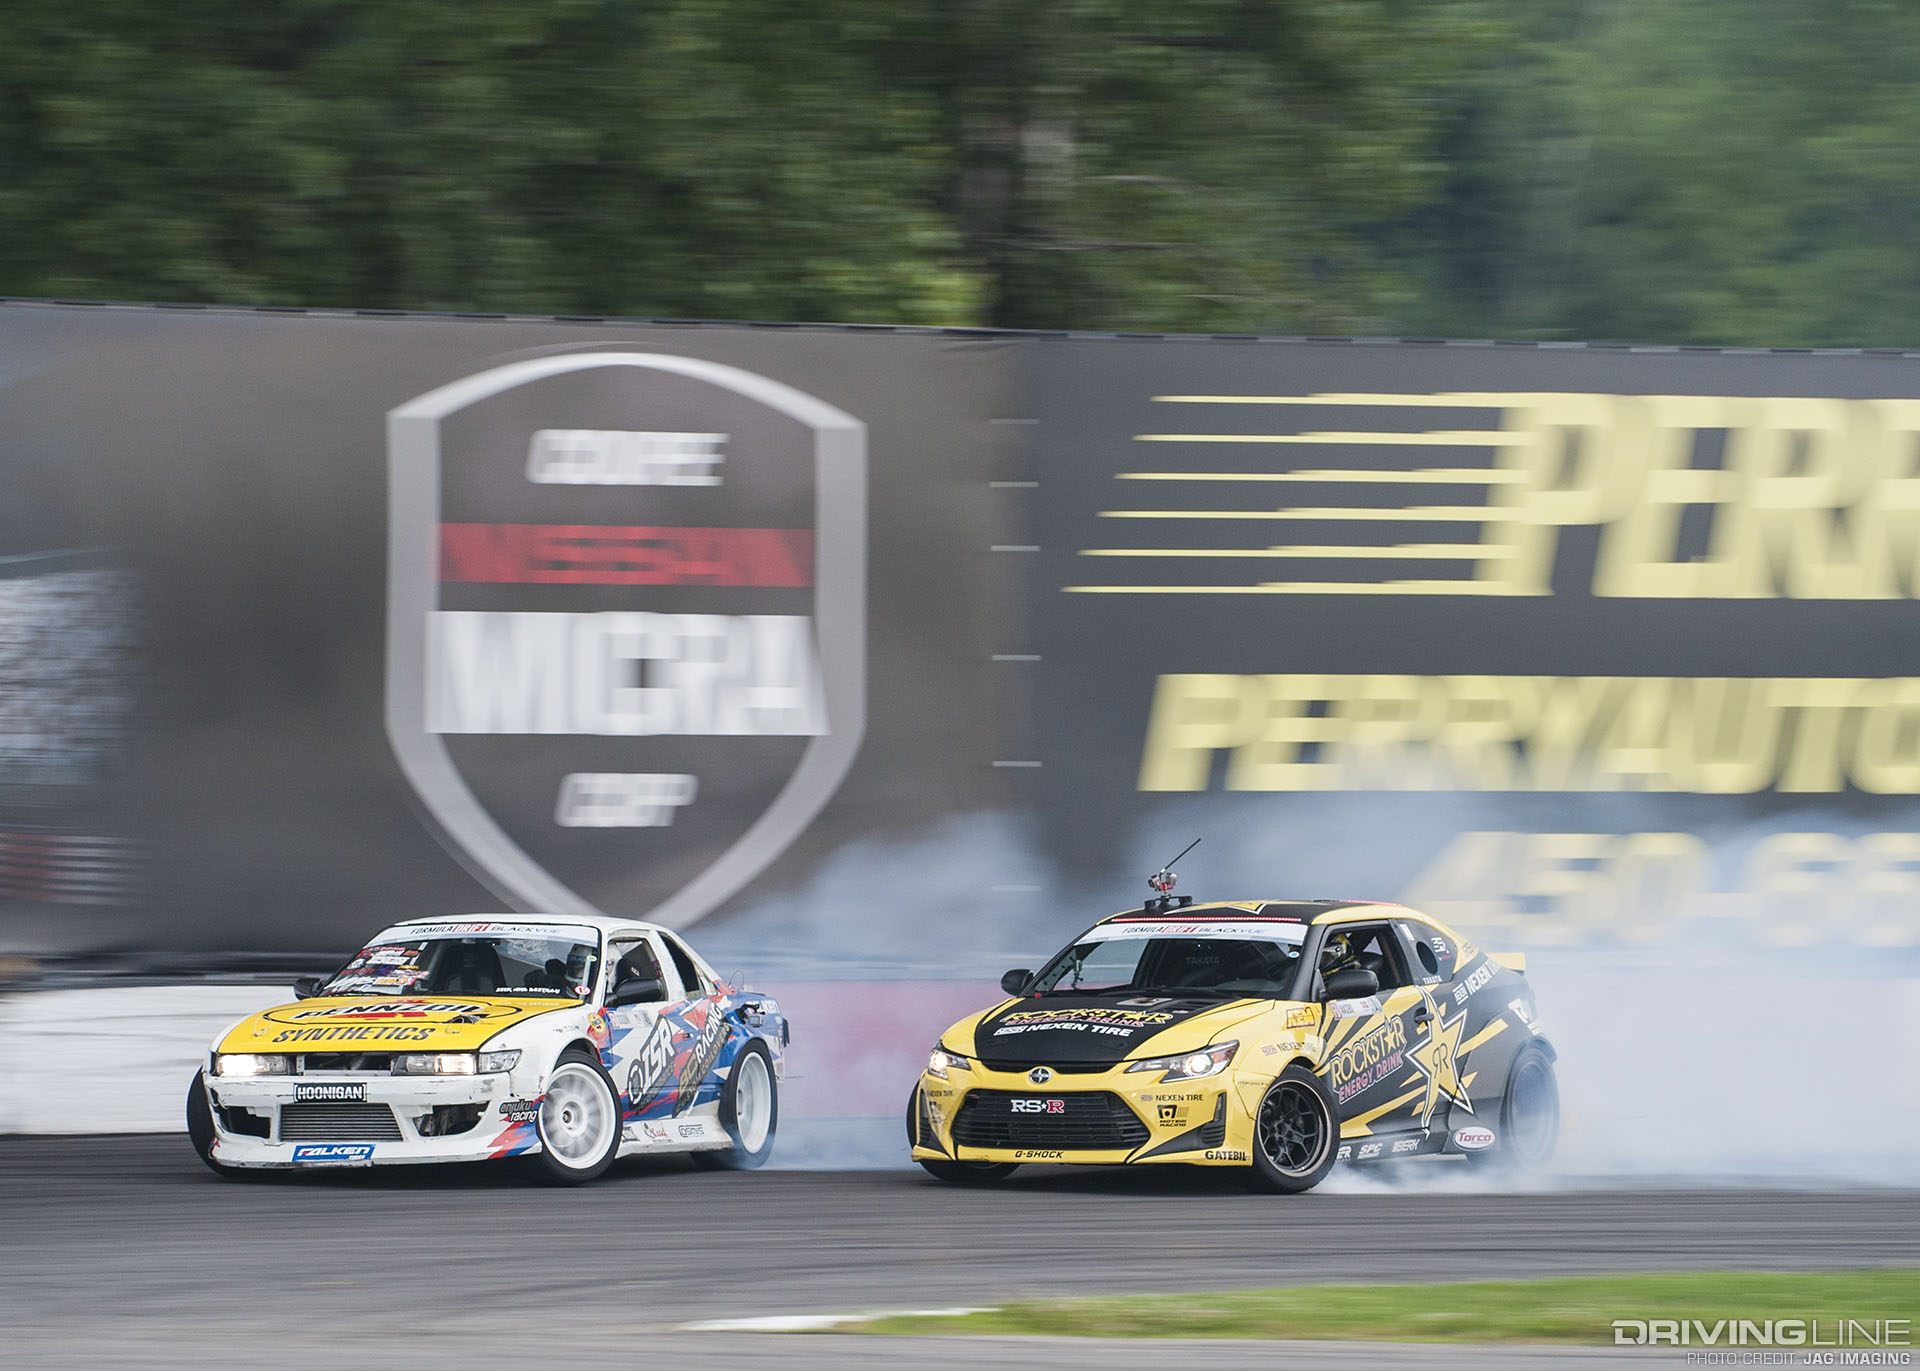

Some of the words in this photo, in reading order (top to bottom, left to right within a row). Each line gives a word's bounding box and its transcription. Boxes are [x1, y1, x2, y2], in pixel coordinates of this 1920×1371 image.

[425, 611, 832, 736] MICRA
[410, 926, 453, 935] FORMULA
[272, 1026, 437, 1043] SYNTHETICS
[694, 1001, 724, 1064] RACING
[1026, 1022, 1086, 1031] NEXEN
[1091, 1025, 1134, 1036] TIRE
[1329, 1018, 1406, 1089] ROCKSTAR
[1339, 1067, 1374, 1101] ENERGY
[1375, 1048, 1402, 1078] DRINK
[500, 1100, 532, 1113] enjuku
[510, 1110, 537, 1123] racing
[1458, 1131, 1492, 1142] Torco
[297, 1146, 371, 1157] FALKEN
[1015, 1150, 1065, 1159] G-SHOCK
[1205, 1150, 1247, 1161] GATEBIL
